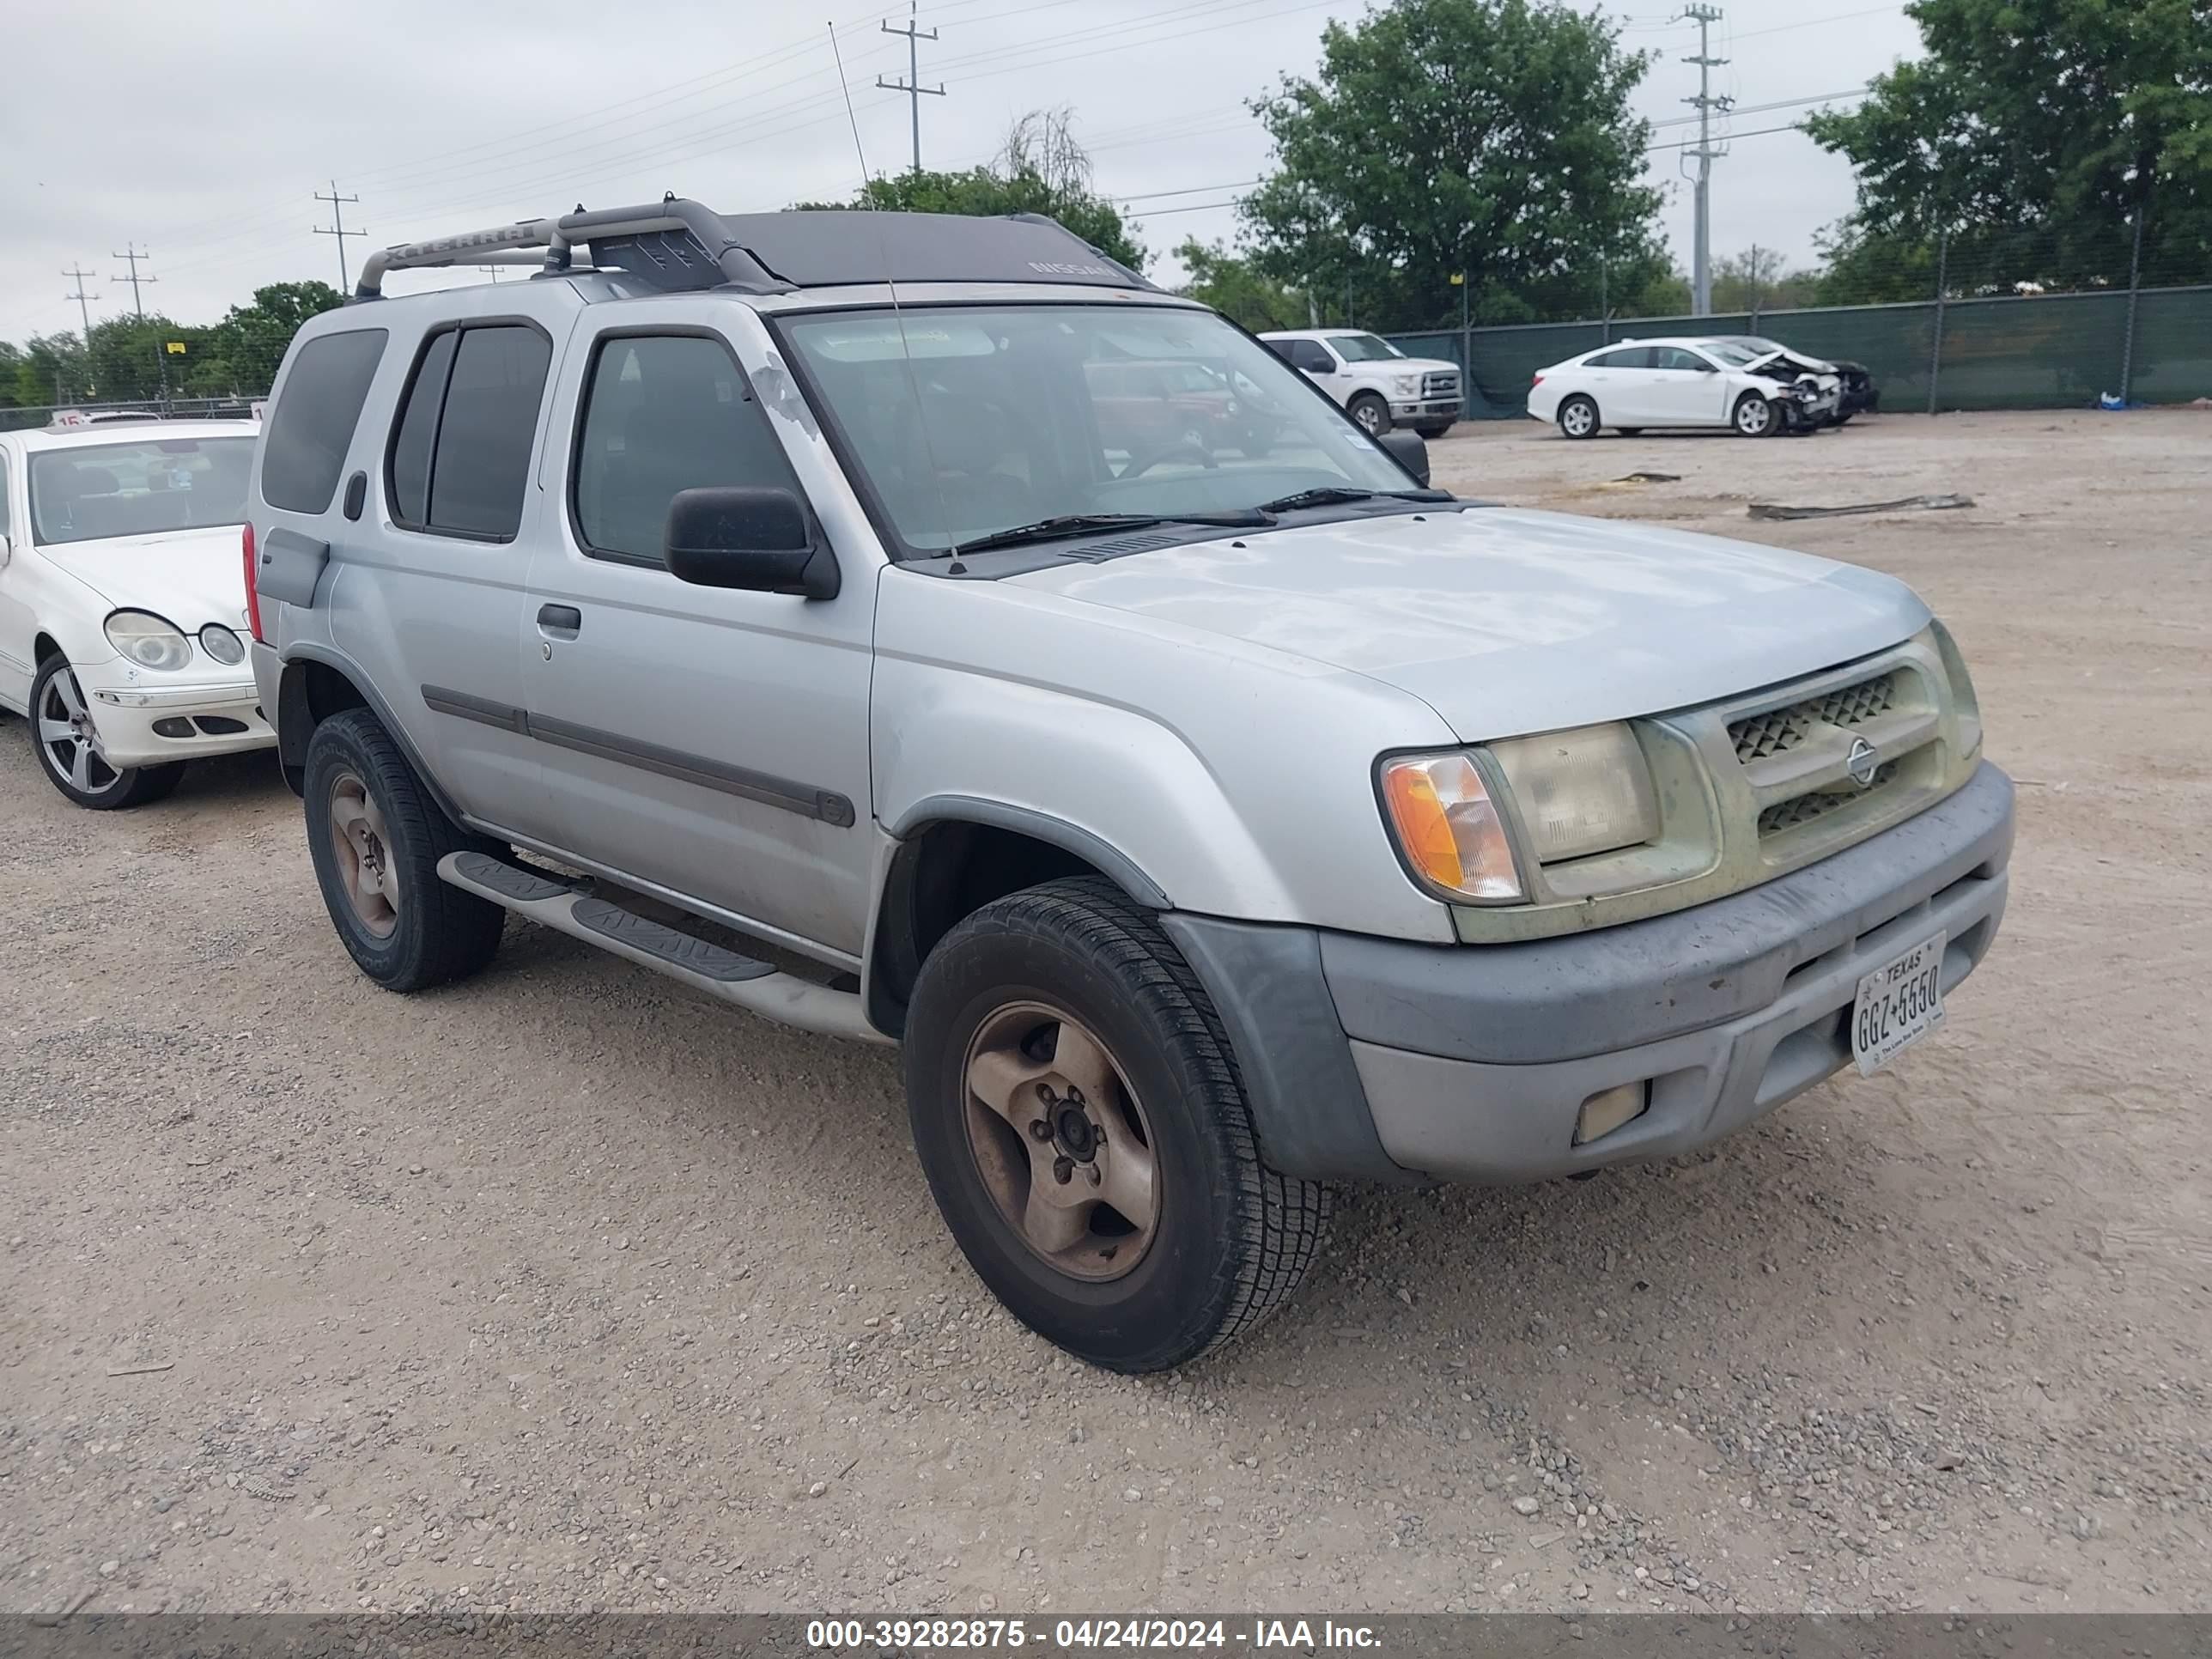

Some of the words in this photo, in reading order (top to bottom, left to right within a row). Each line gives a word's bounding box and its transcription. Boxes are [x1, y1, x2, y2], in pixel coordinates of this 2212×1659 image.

[385, 226, 534, 263] XTERRA
[1028, 262, 1118, 278] NISSAN
[1887, 951, 1922, 984] TEXAS
